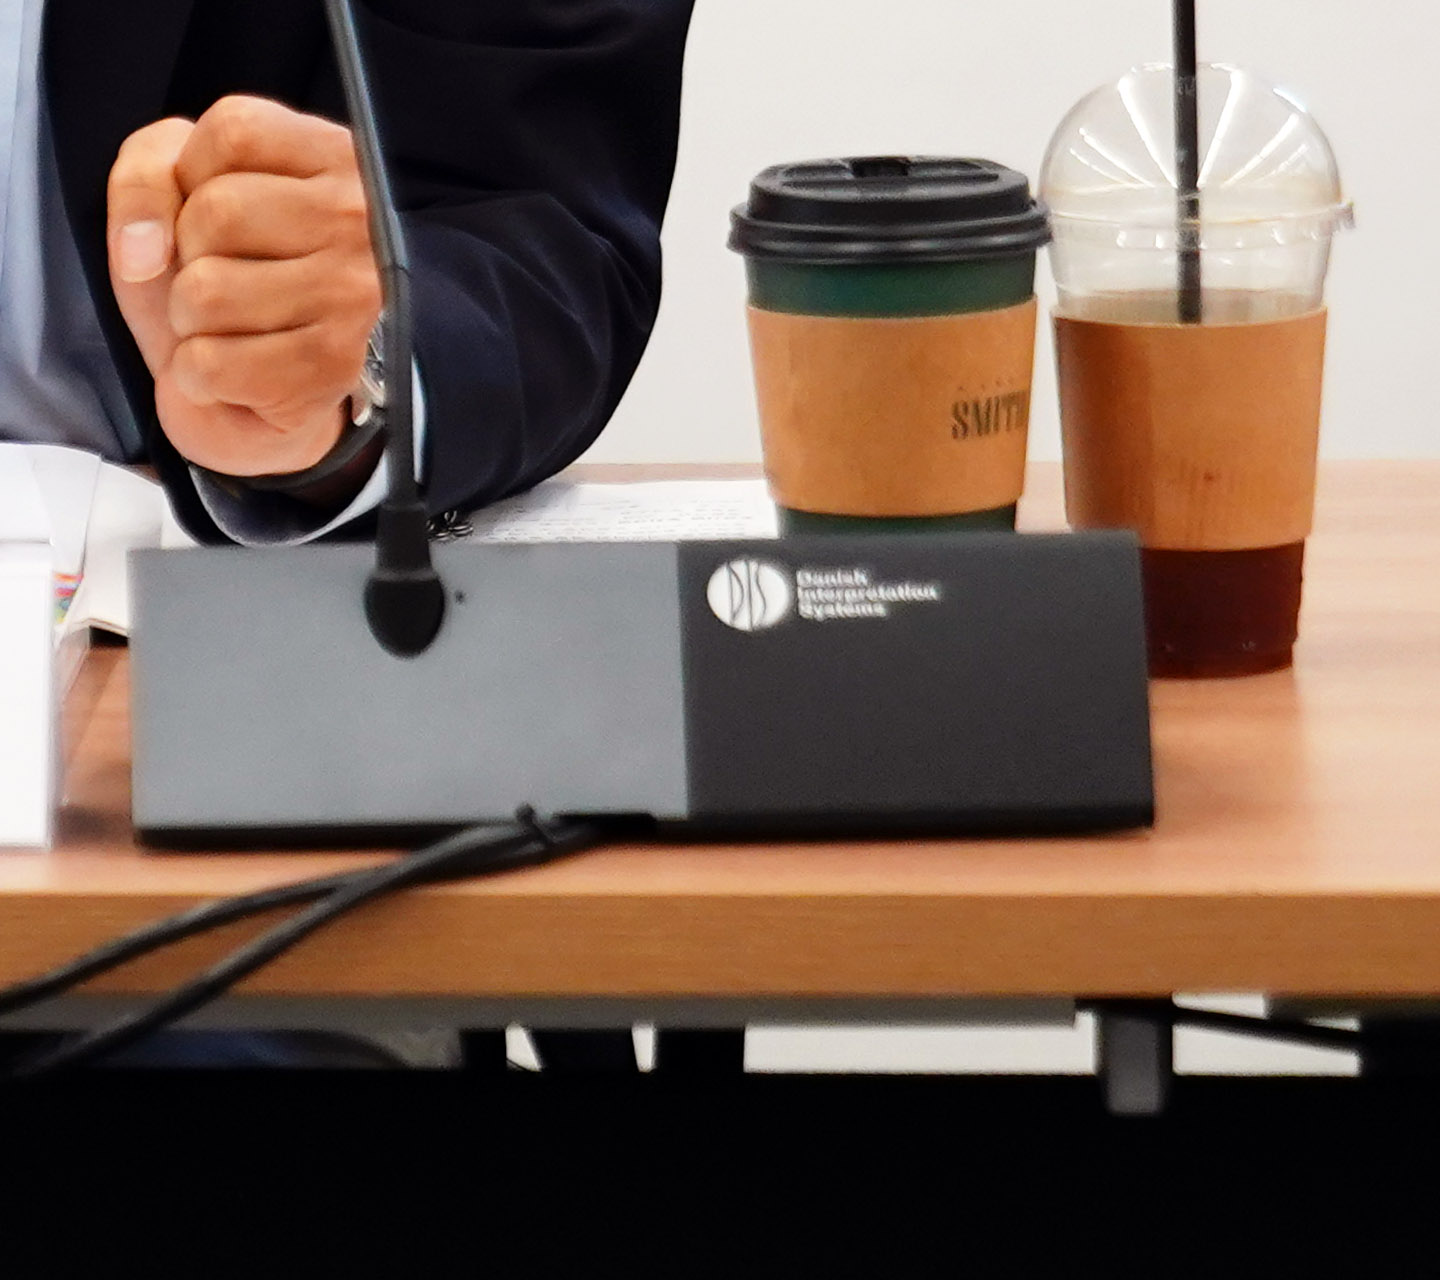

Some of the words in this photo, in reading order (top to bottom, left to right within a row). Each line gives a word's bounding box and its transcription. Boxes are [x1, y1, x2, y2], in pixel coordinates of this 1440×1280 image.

[796, 568, 868, 586] Danish
[797, 584, 939, 604] Interpretation
[798, 602, 887, 621] Systems
